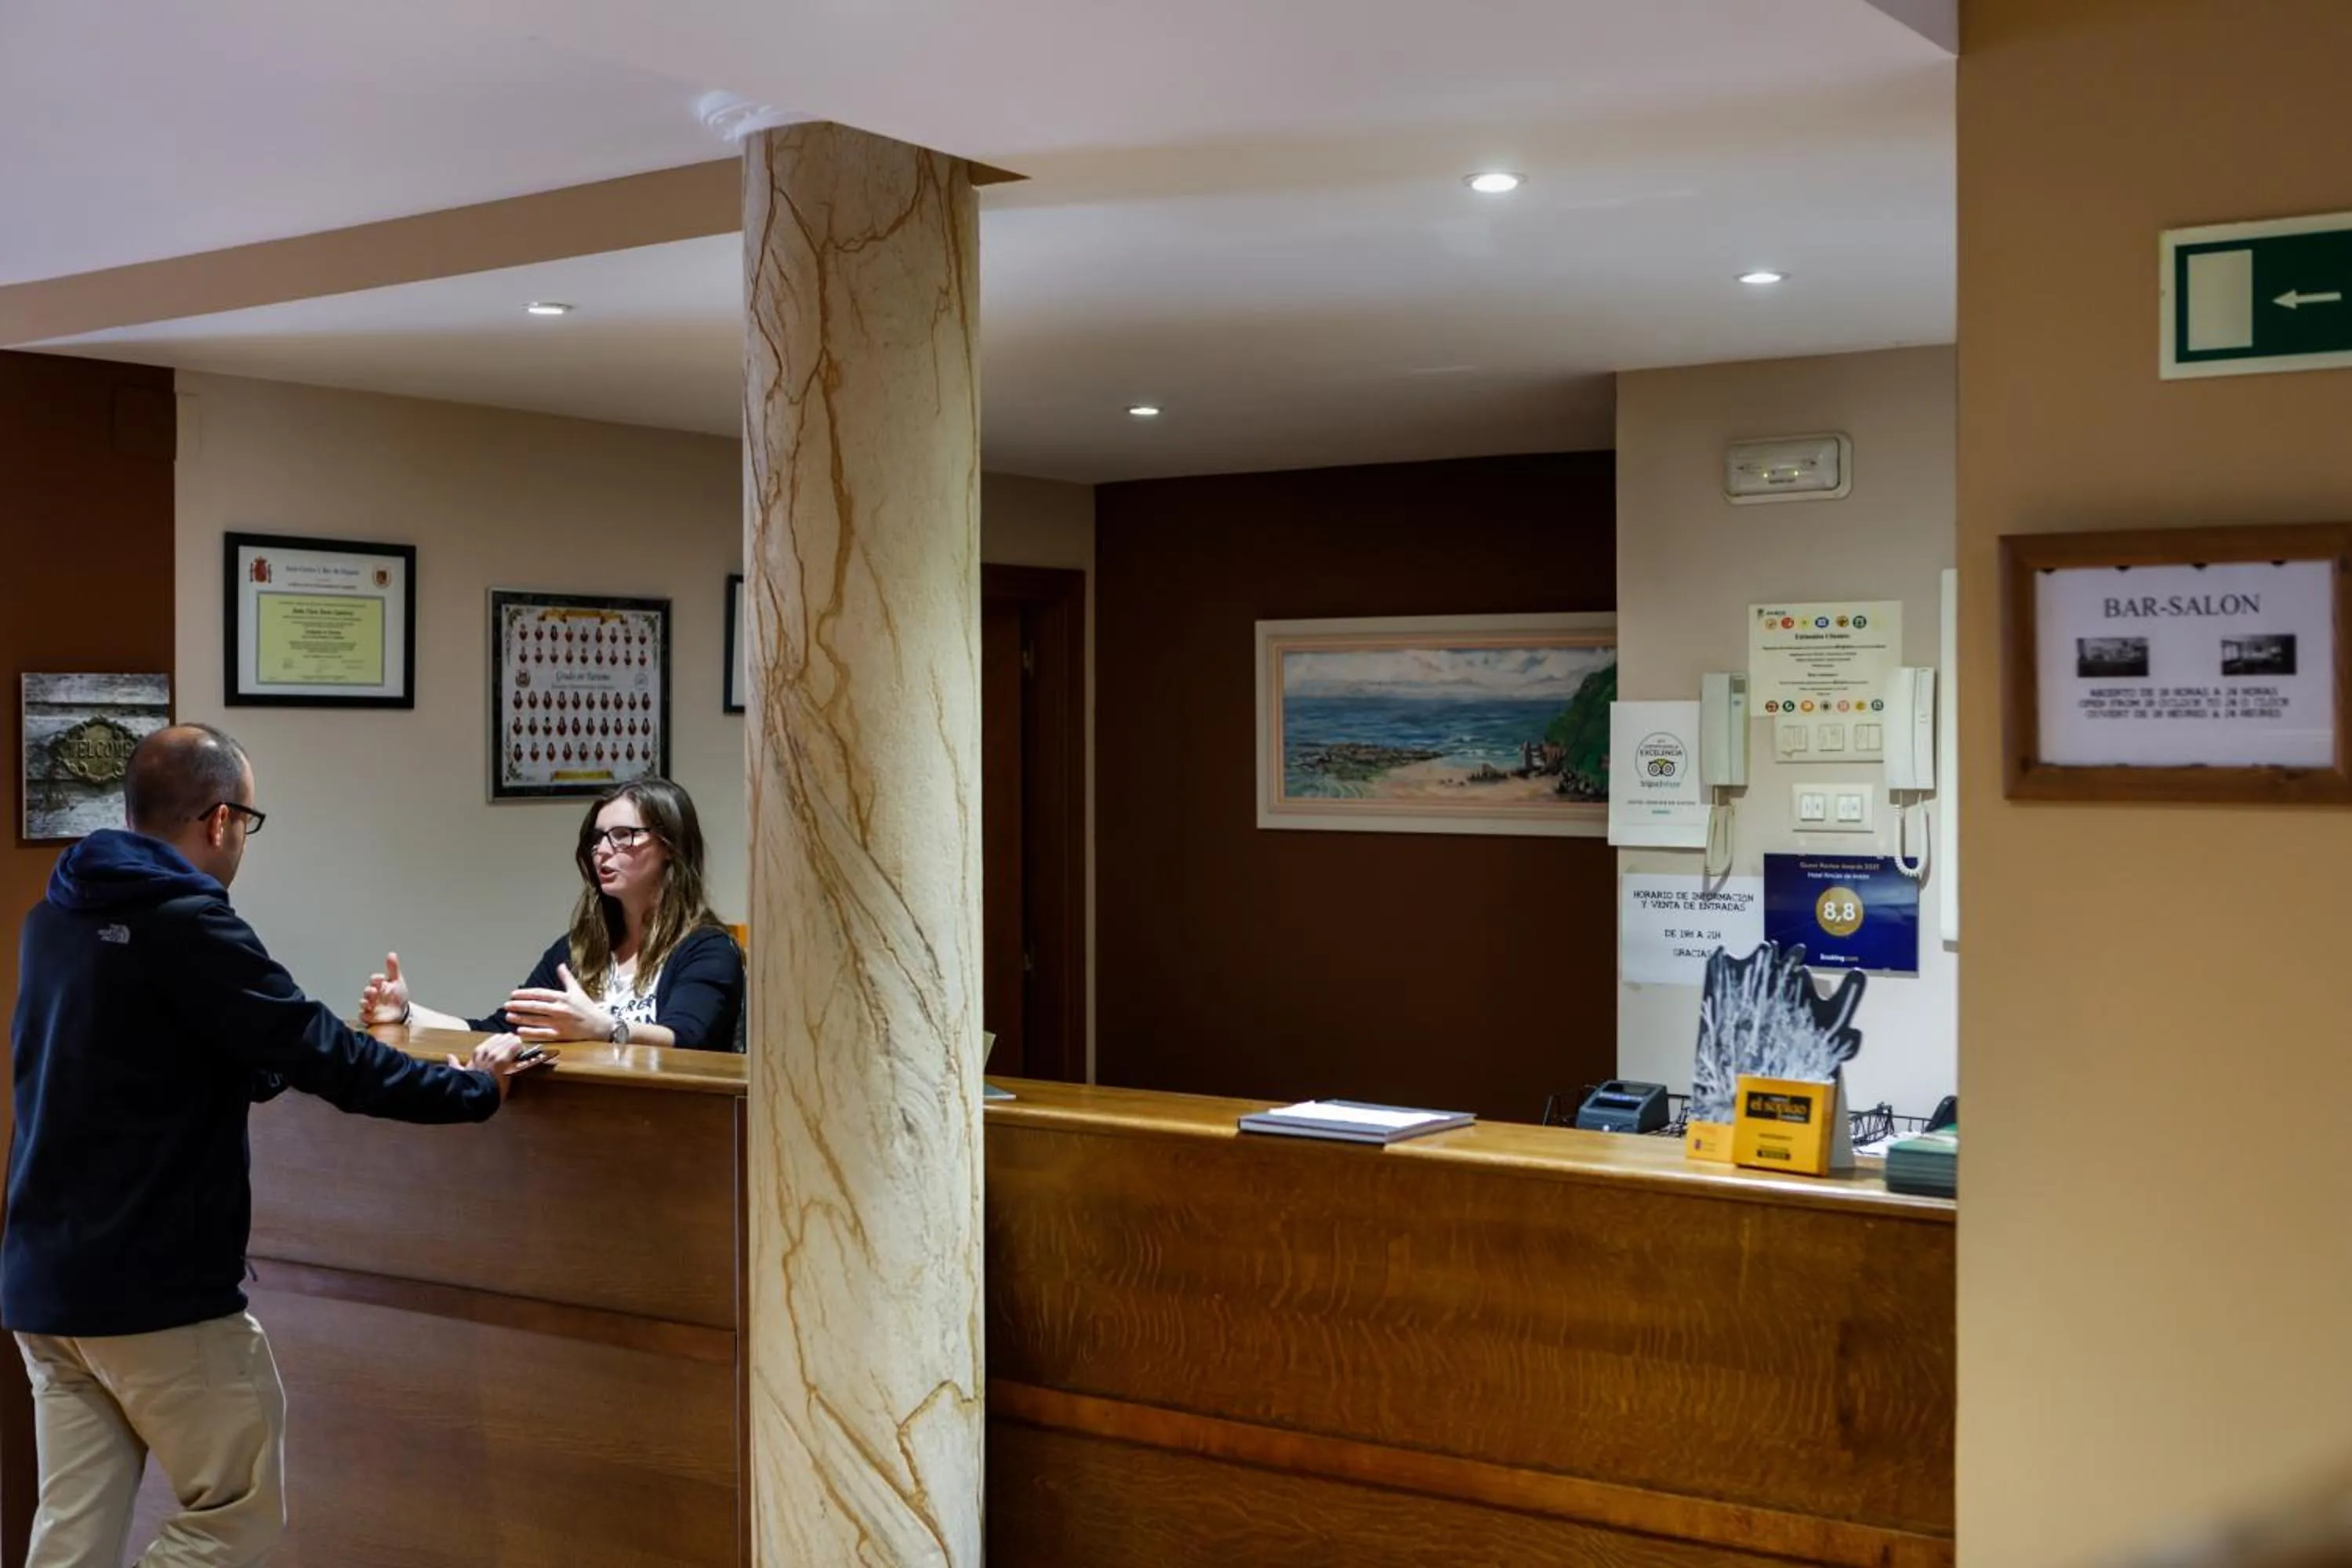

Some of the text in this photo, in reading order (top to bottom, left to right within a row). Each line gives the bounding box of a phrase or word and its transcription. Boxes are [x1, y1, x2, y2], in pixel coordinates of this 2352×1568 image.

[2103, 593, 2260, 619] BAR-SALON
[1633, 890, 1673, 900] HORARIO
[1675, 891, 1687, 901] DE
[1641, 900, 1746, 912] Y VENTA DE ENTRADAS
[1824, 901, 1856, 924] 8,8
[1664, 928, 1676, 938] DE
[1696, 930, 1704, 938] A
